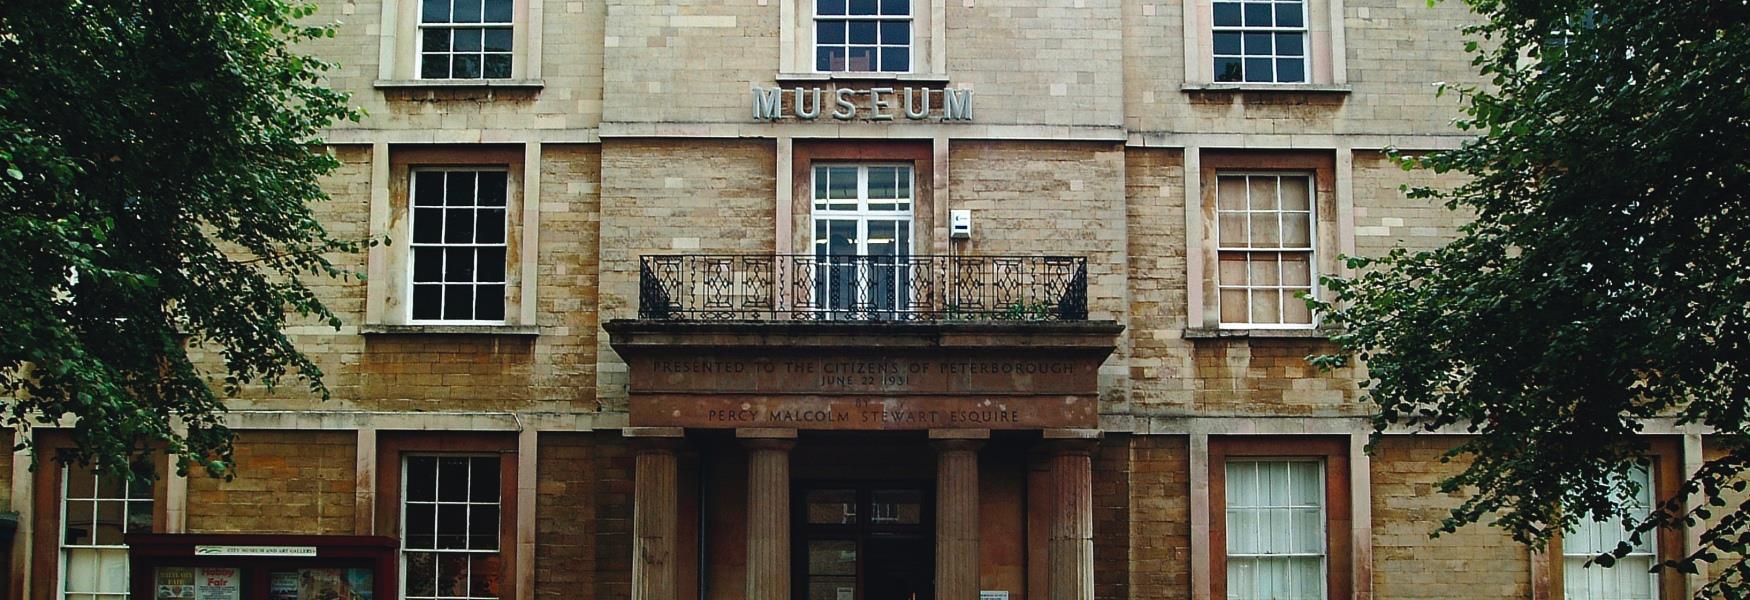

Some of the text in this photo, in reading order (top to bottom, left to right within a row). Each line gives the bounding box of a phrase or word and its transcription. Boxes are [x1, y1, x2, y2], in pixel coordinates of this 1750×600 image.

[752, 86, 973, 121] MUSEUM
[653, 361, 1074, 374] PRESENTED TO THE CITIZENS OF PETERBOROUGH
[821, 375, 909, 386] JUNE 22 1931
[708, 410, 1019, 424] PERCY MALCOLM STEWART ESQUIRE
[207, 578, 228, 586] Fair
